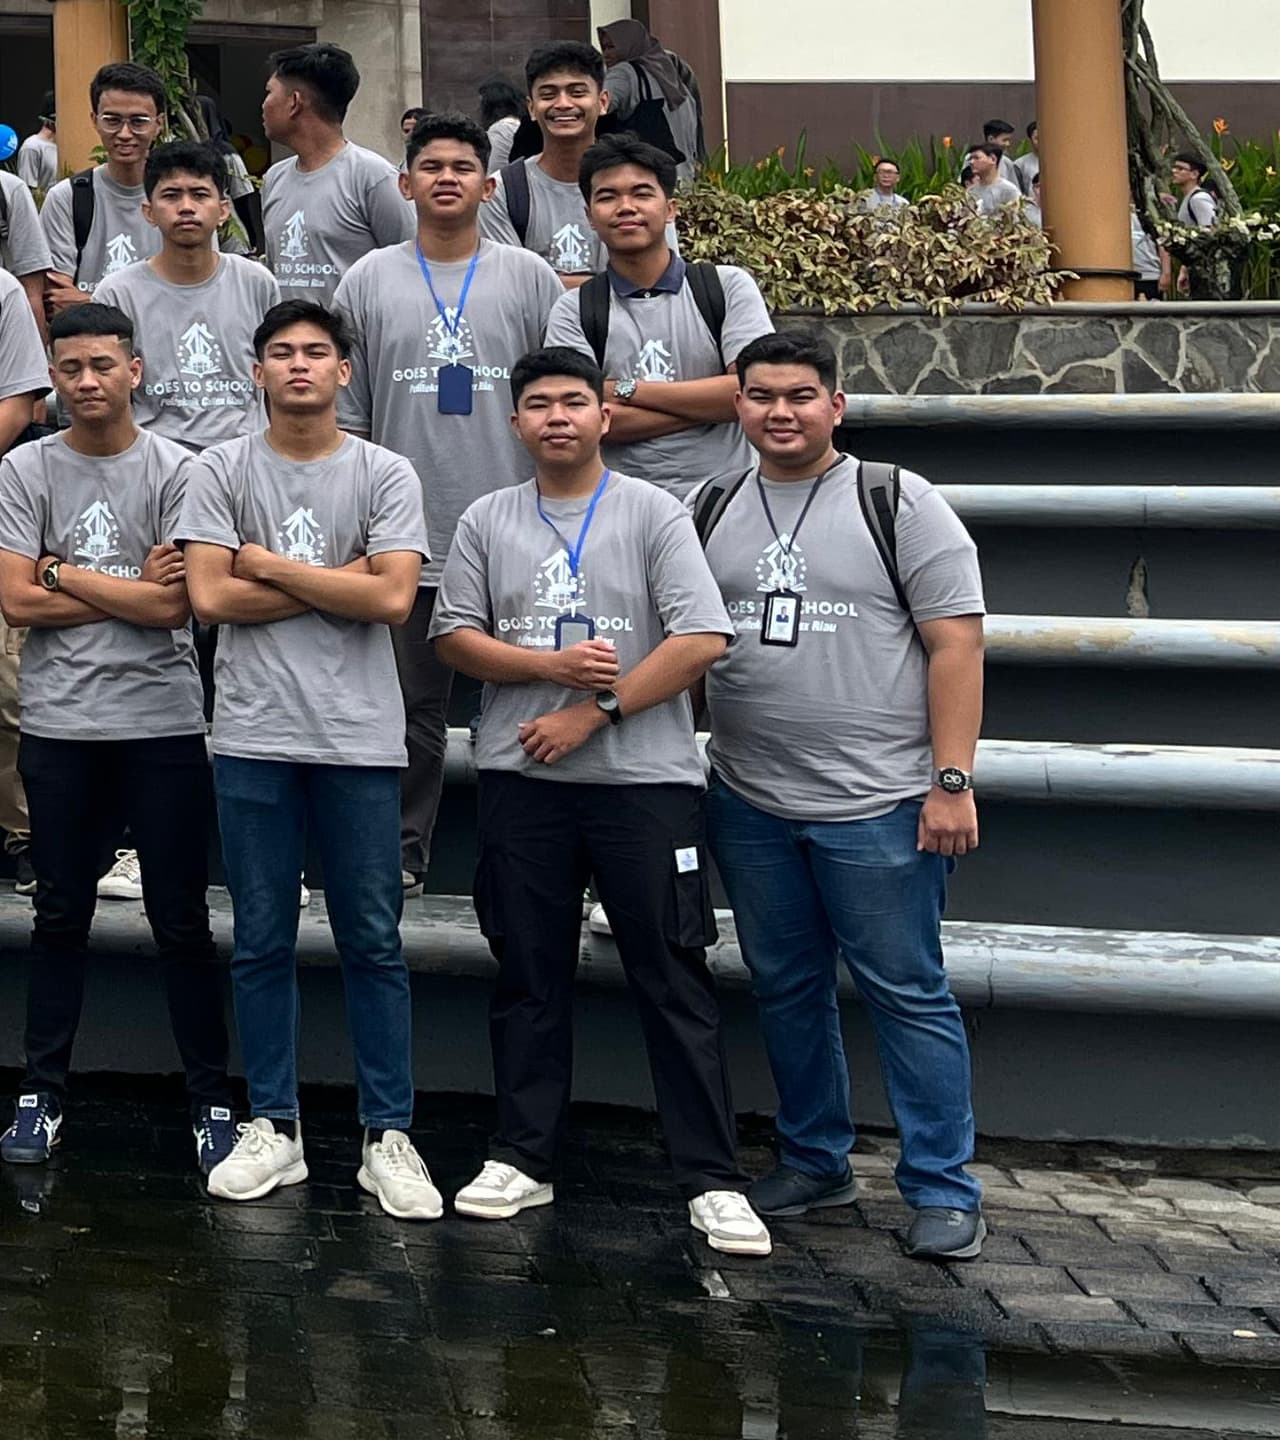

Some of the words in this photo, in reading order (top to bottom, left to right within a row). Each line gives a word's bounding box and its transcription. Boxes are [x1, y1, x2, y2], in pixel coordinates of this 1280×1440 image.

[281, 263, 292, 274] TO
[294, 264, 339, 275] SCHOOL
[392, 366, 428, 382] GOES
[431, 366, 439, 378] T
[472, 365, 510, 379] HOOL
[145, 382, 179, 396] GOES
[183, 381, 201, 393] TO
[205, 380, 254, 393] SCHOOL
[100, 565, 142, 578] SCHO
[727, 601, 755, 614] OES
[594, 616, 633, 632] OOL
[811, 621, 837, 633] Riau
